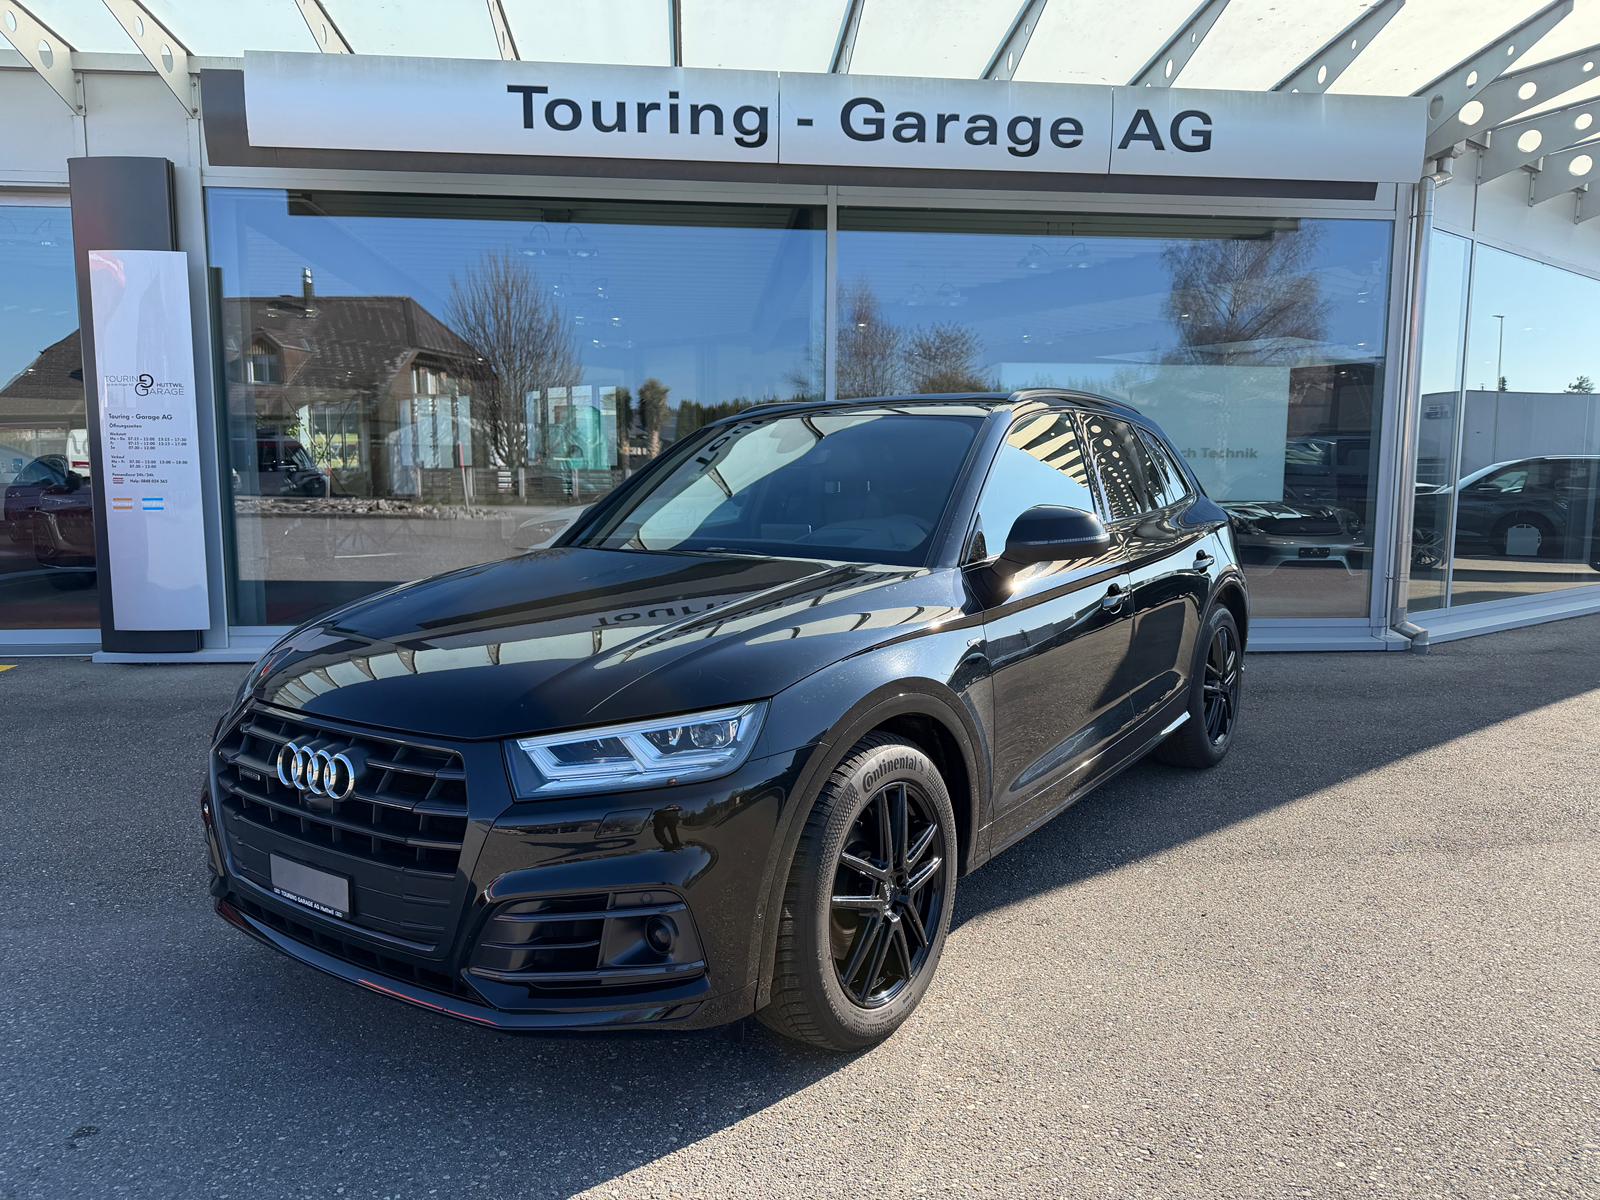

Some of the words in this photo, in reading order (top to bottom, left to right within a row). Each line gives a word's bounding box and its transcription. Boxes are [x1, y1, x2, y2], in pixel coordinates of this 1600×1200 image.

[507, 84, 769, 148] Touring
[797, 118, 813, 126] -
[840, 96, 1085, 157] Garage
[1117, 108, 1213, 153] AG
[135, 382, 185, 396] GARAGE
[1201, 447, 1258, 459] Technik
[862, 755, 917, 793] Continental
[280, 890, 298, 902] TOURING
[297, 896, 314, 908] GARAGE
[313, 902, 320, 910] AG
